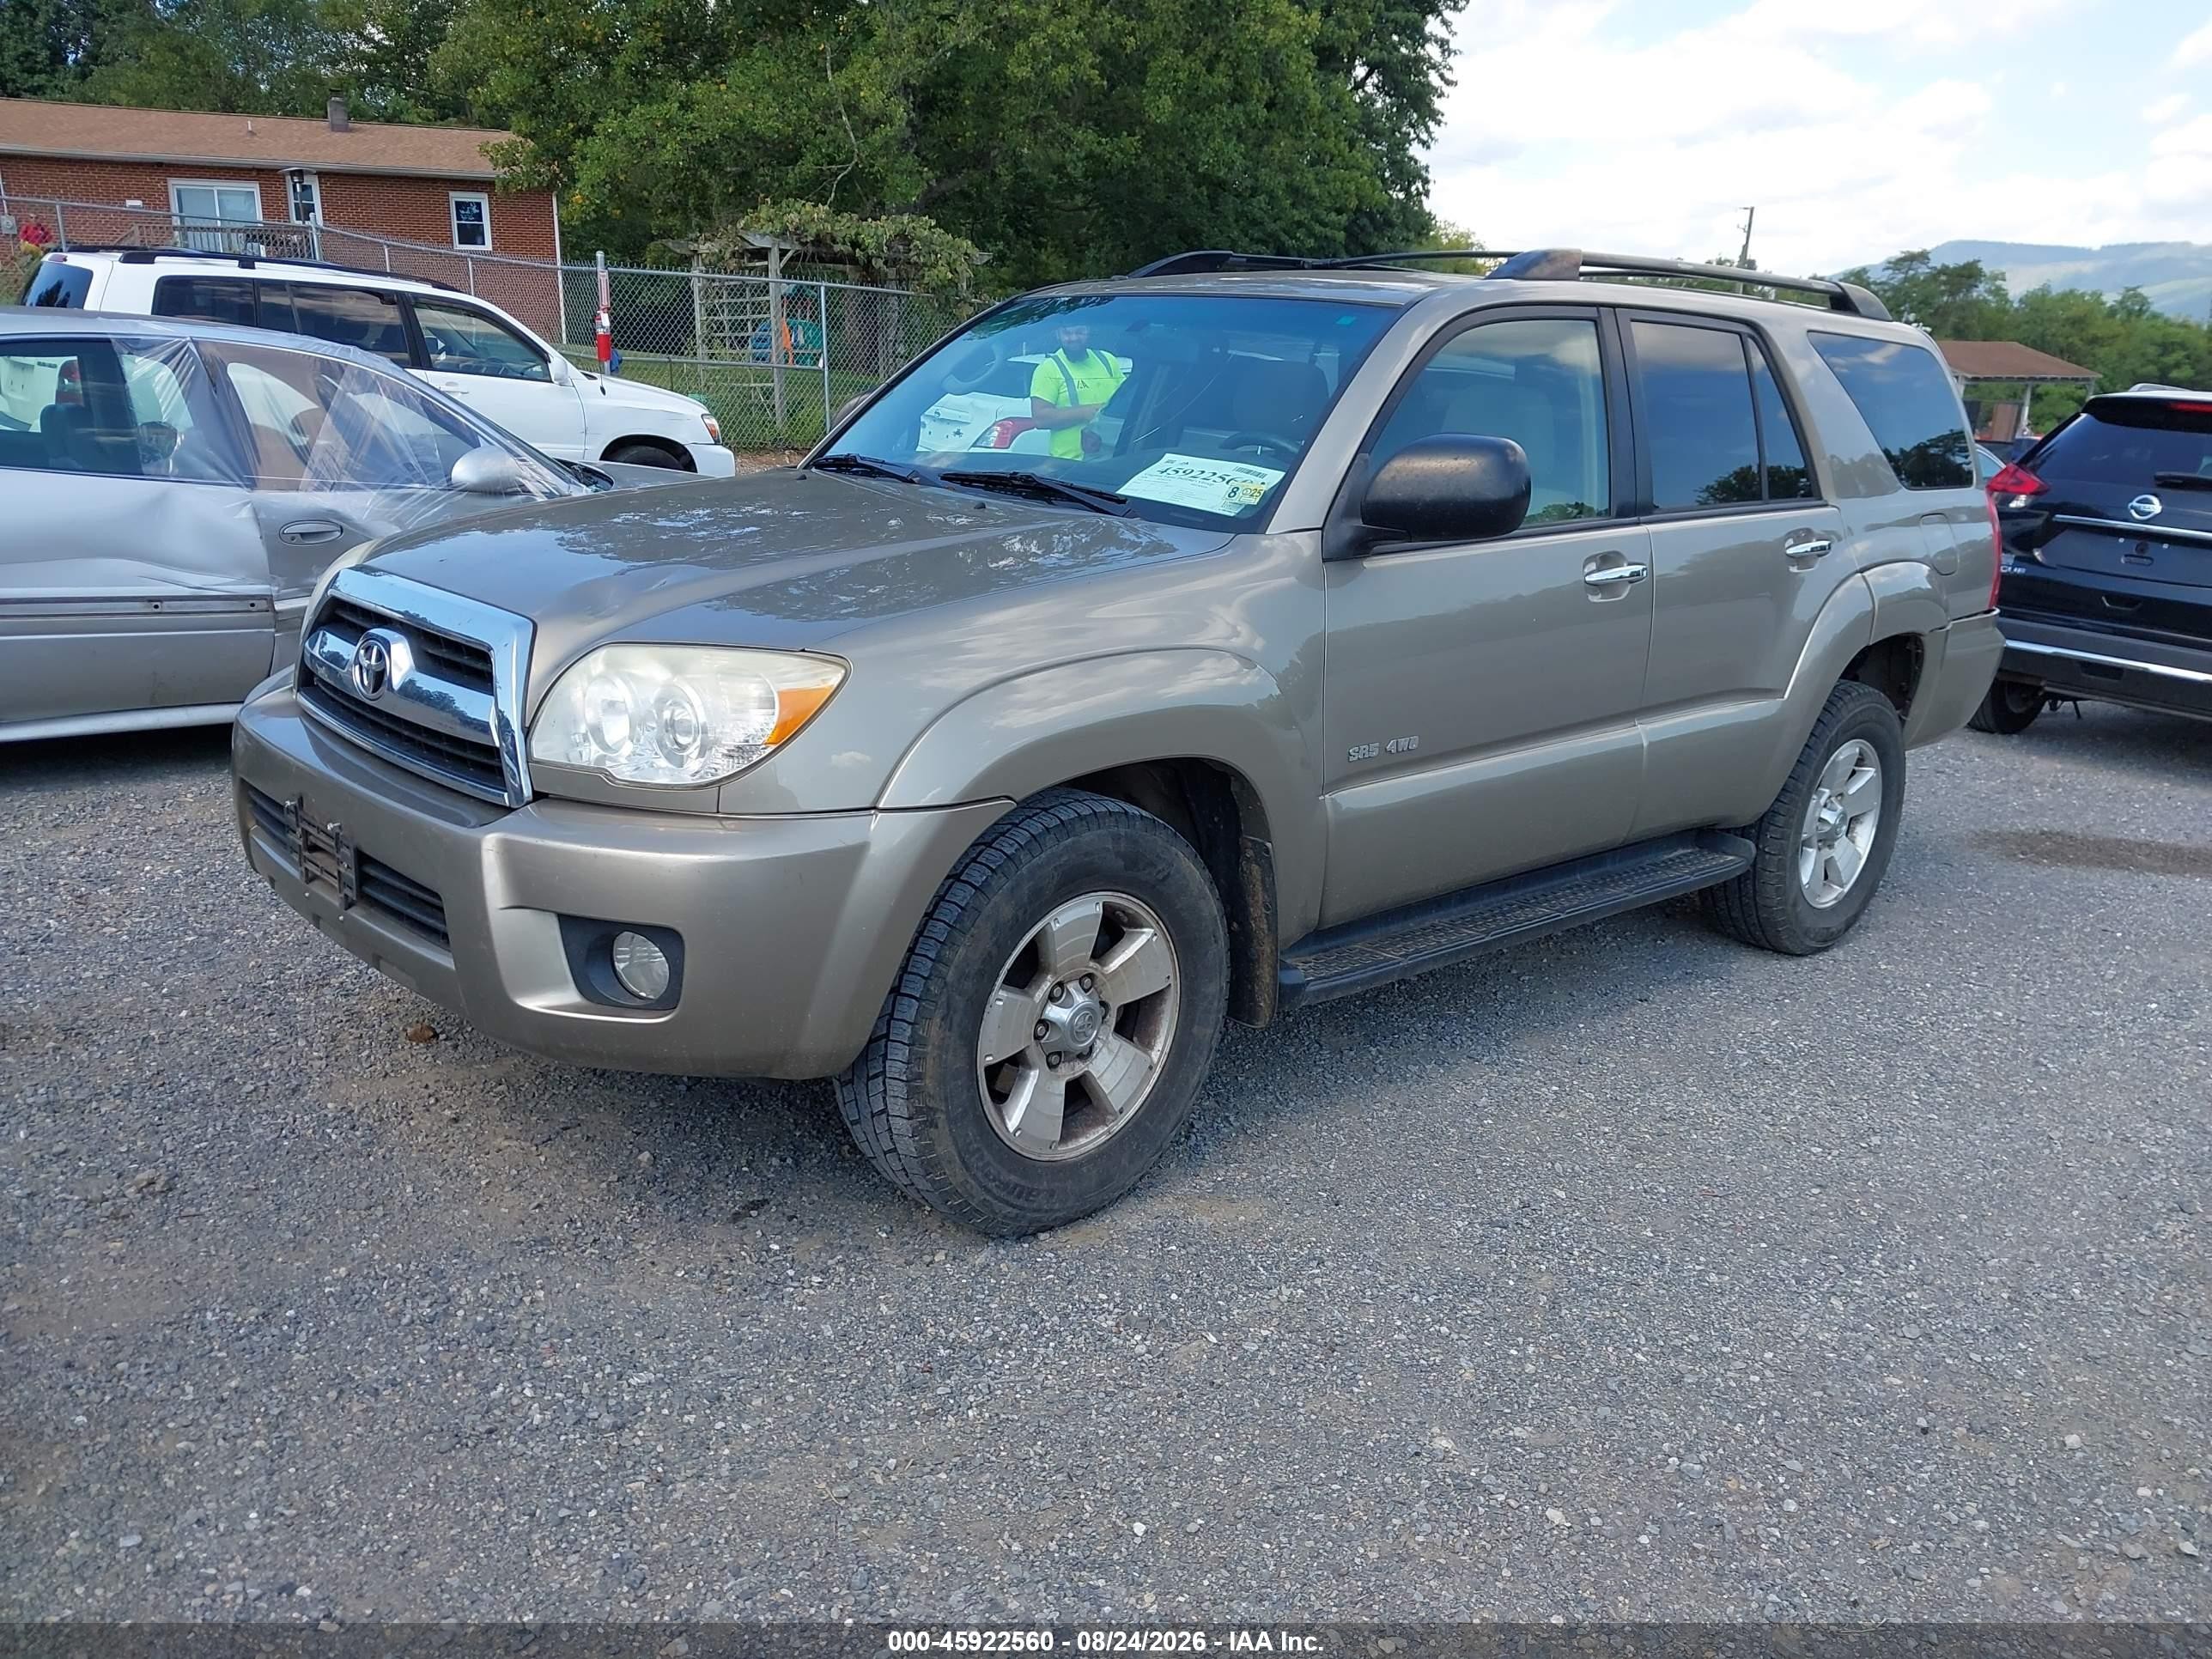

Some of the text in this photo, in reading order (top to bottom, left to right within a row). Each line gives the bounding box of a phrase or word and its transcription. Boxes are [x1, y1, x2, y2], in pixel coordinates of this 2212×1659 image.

[1228, 486, 1240, 498] 8
[1250, 488, 1264, 498] 25
[1348, 742, 1380, 763] SR5
